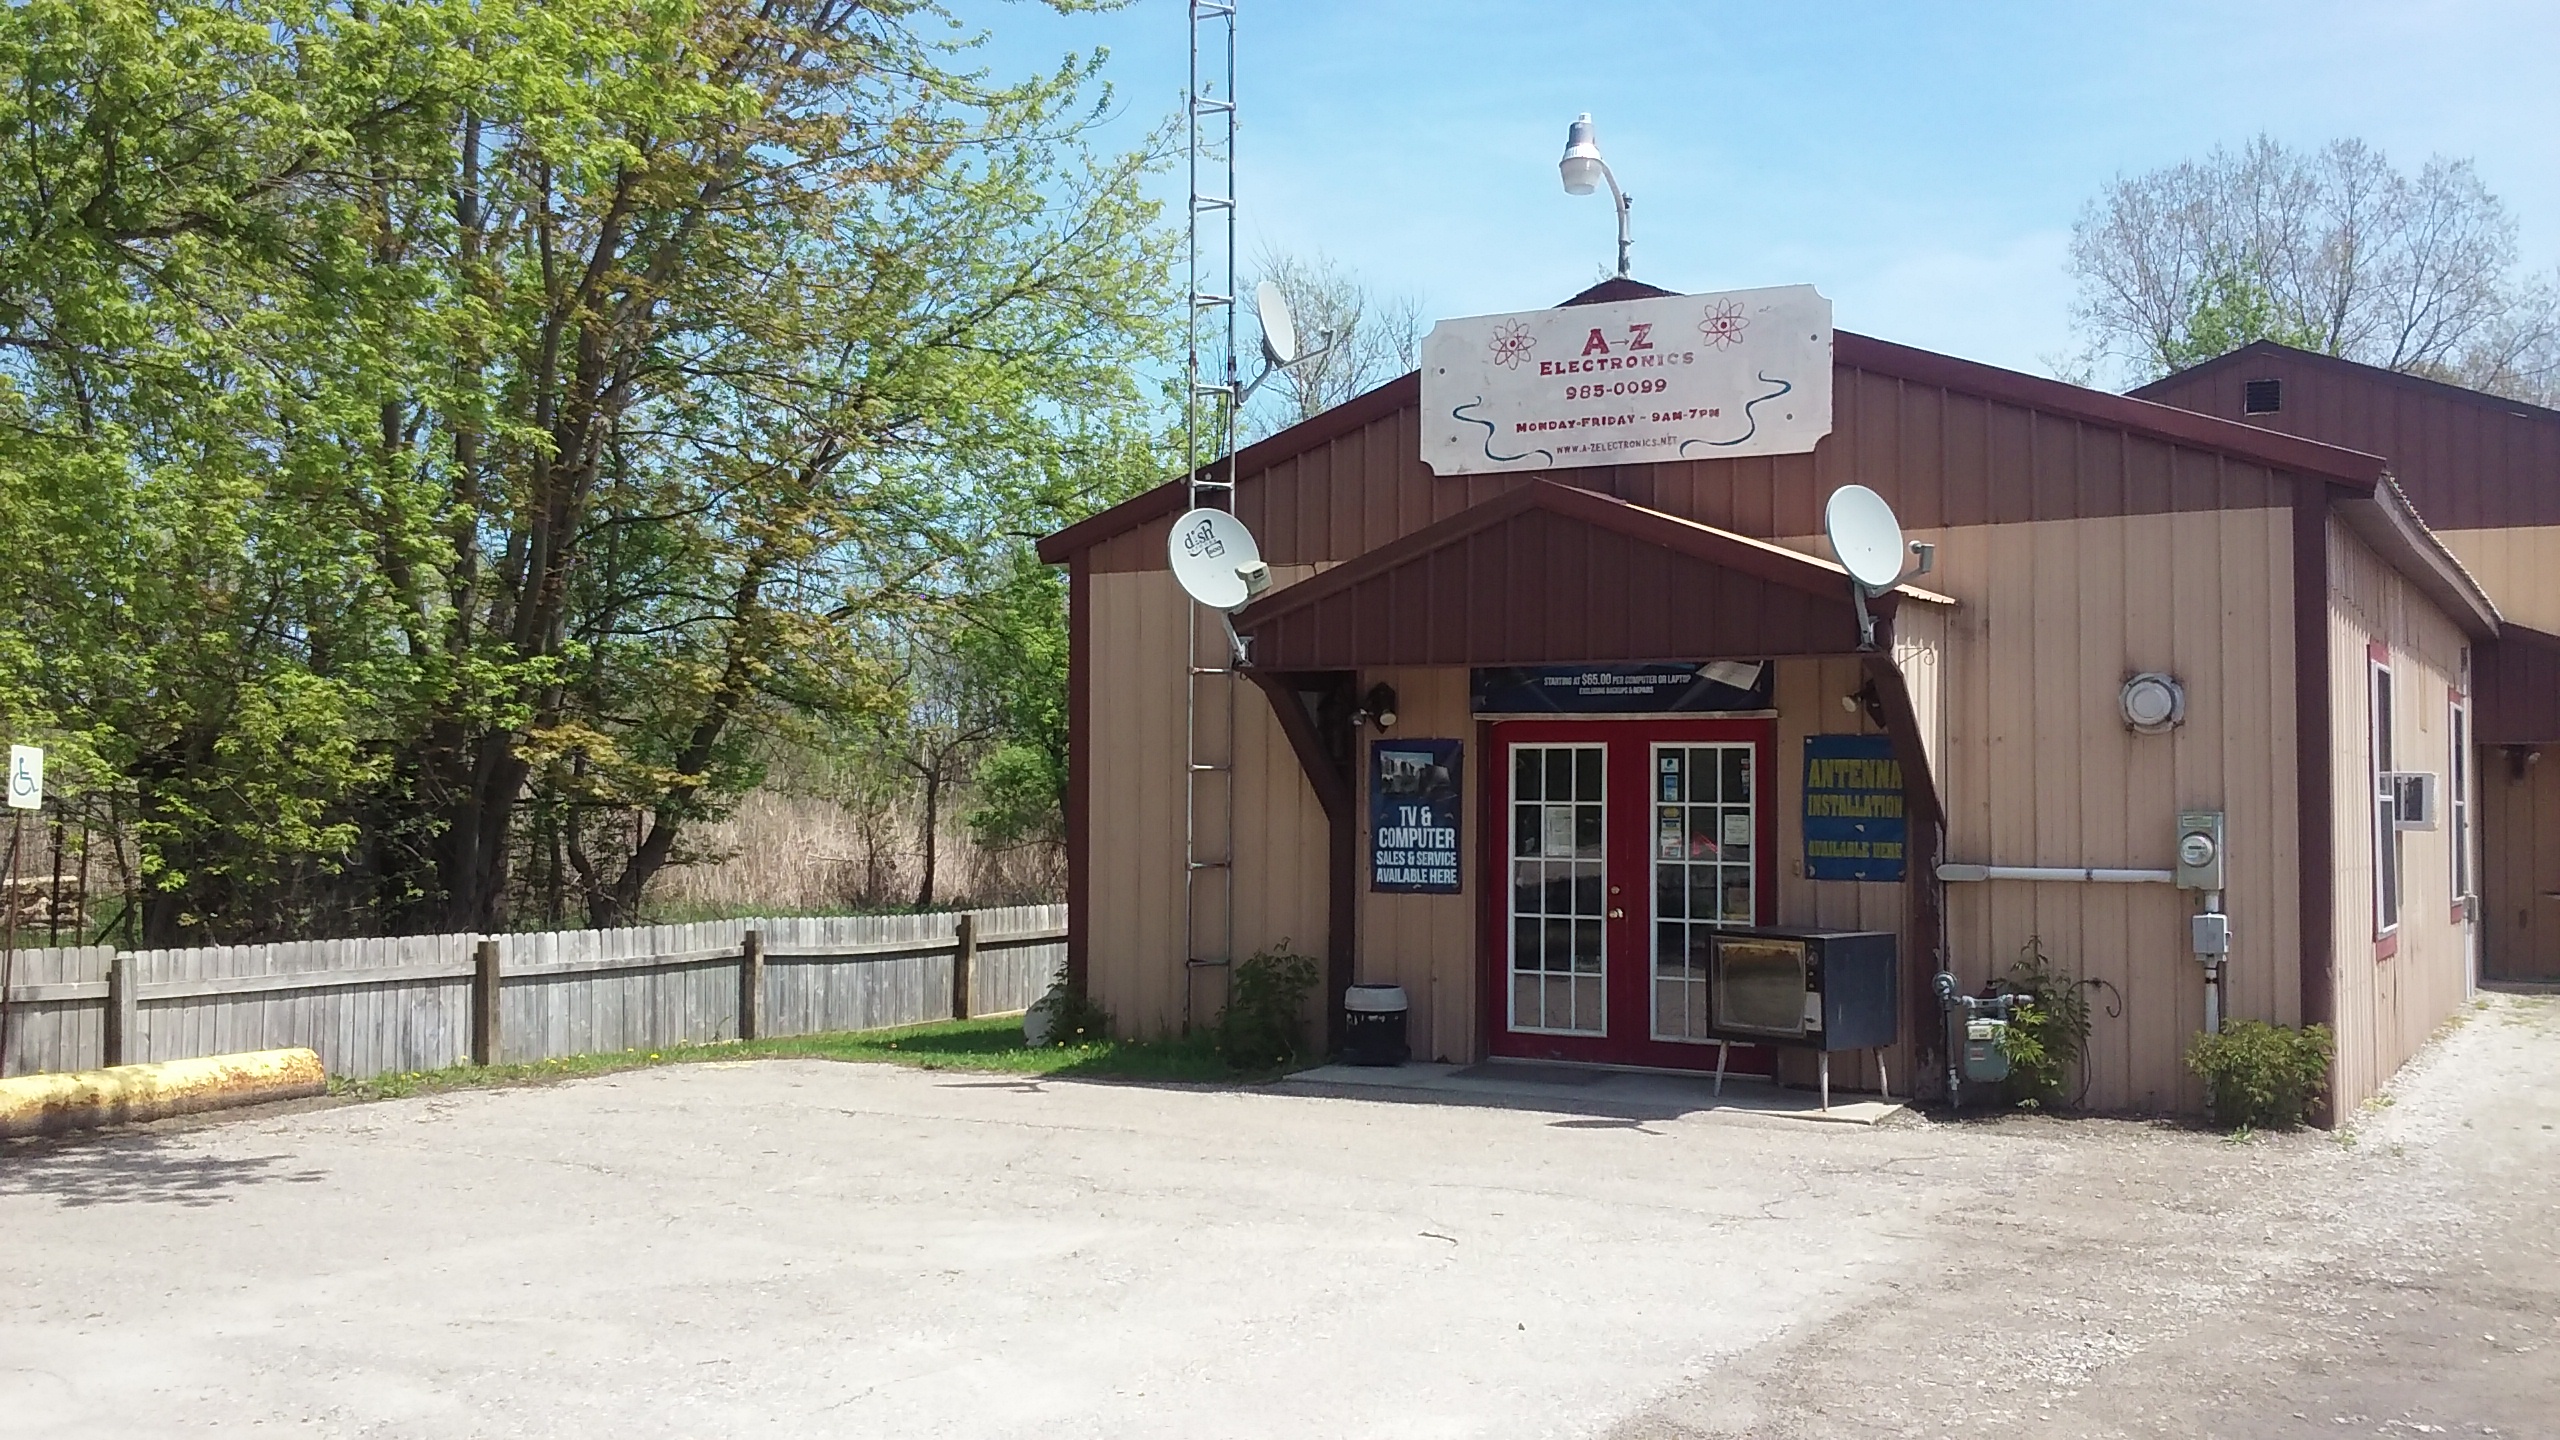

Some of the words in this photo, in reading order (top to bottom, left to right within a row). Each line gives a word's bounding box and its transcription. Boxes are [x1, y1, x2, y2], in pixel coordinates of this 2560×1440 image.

[1539, 352, 1695, 376] ELECTRONICS
[1565, 378, 1668, 400] 985-0099
[1516, 414, 1635, 433] MONDAY-FRIDAY
[1184, 526, 1215, 549] dish
[1544, 676, 1572, 686] STARTING
[1573, 676, 1581, 685] AT
[1581, 673, 1611, 686] $65.00
[1612, 675, 1624, 685] PER
[1625, 675, 1657, 685] COMPUTER
[1667, 674, 1692, 684] LAPTOP
[1808, 759, 1903, 789] ANTENNA
[1399, 806, 1416, 826] TV
[1421, 806, 1432, 826] &
[1808, 794, 1903, 818] INSTALLATION
[1378, 827, 1455, 849] COMPUTER
[1376, 851, 1406, 866] SALES
[1407, 851, 1415, 866] &
[1416, 851, 1457, 866] SERVICE
[1808, 840, 1869, 858] AVAILABLE
[1376, 868, 1428, 883] AVAILABLE
[1430, 869, 1457, 884] HERE
